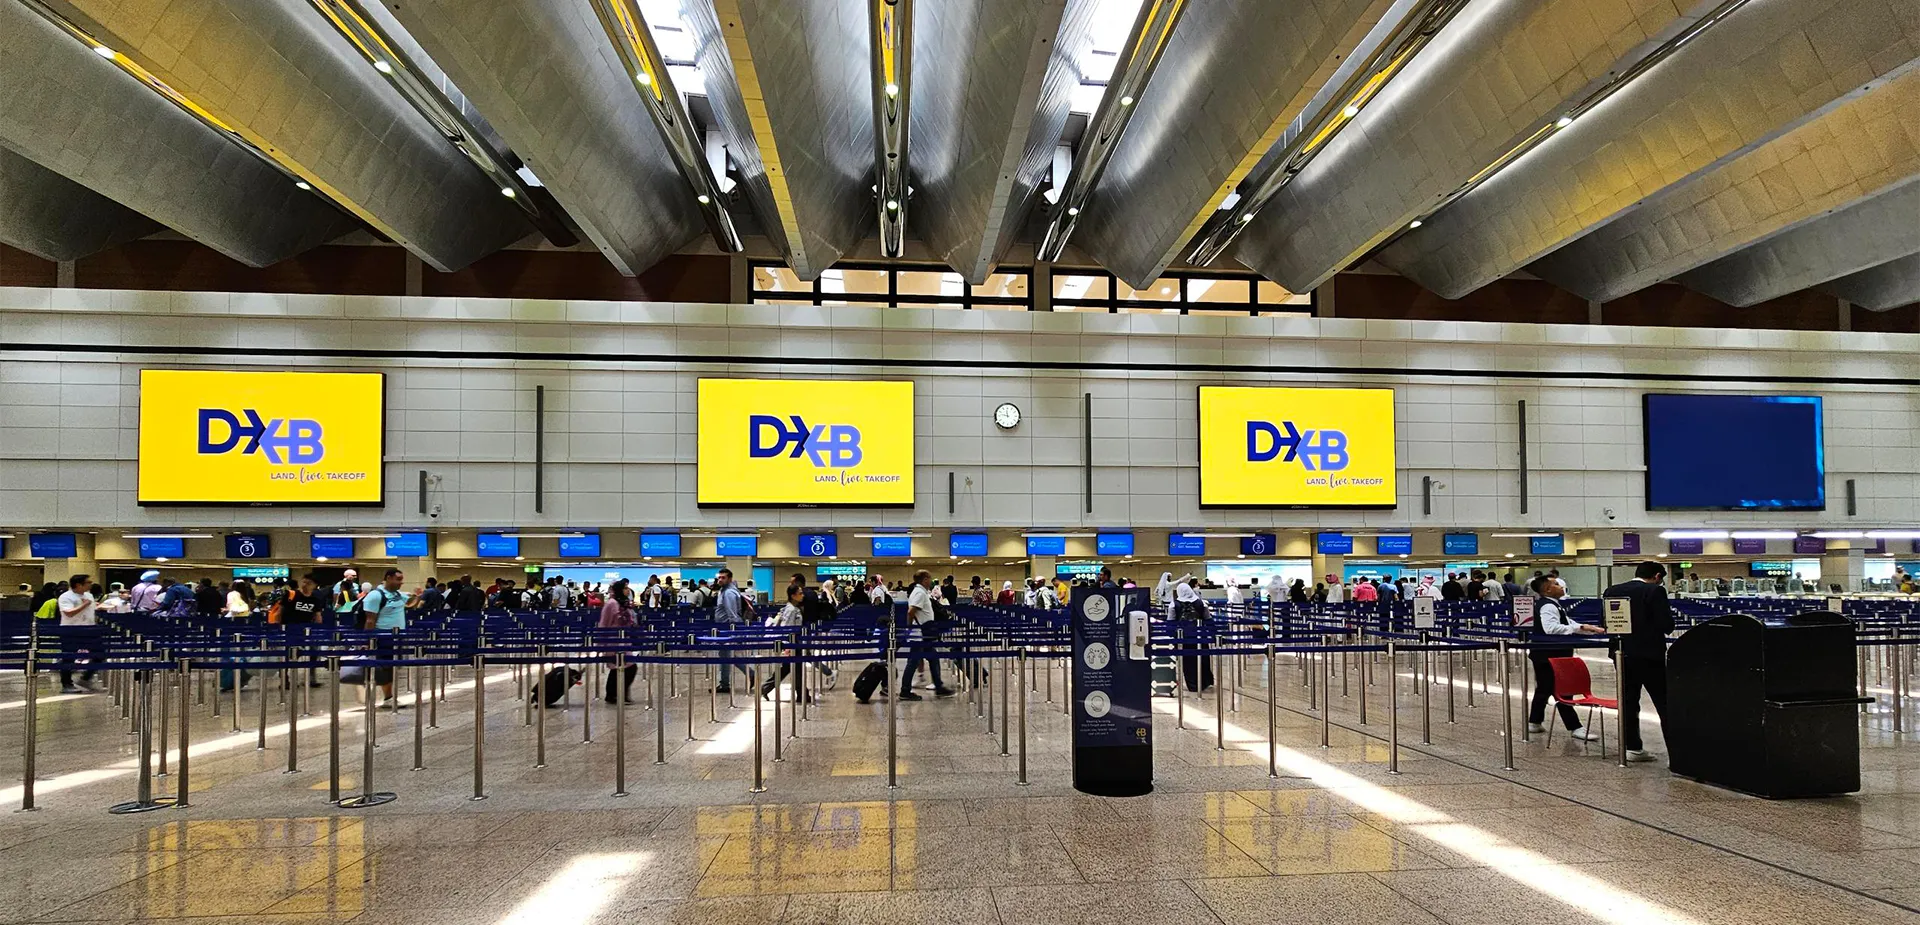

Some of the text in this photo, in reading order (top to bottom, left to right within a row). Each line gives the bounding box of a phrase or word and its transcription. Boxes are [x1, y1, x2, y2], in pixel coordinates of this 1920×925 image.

[270, 472, 297, 480] LAND.
[326, 472, 366, 480] TAKEOFF
[814, 475, 839, 483] LAND.
[864, 475, 900, 483] TAKEOFF
[295, 601, 315, 611] EA7
